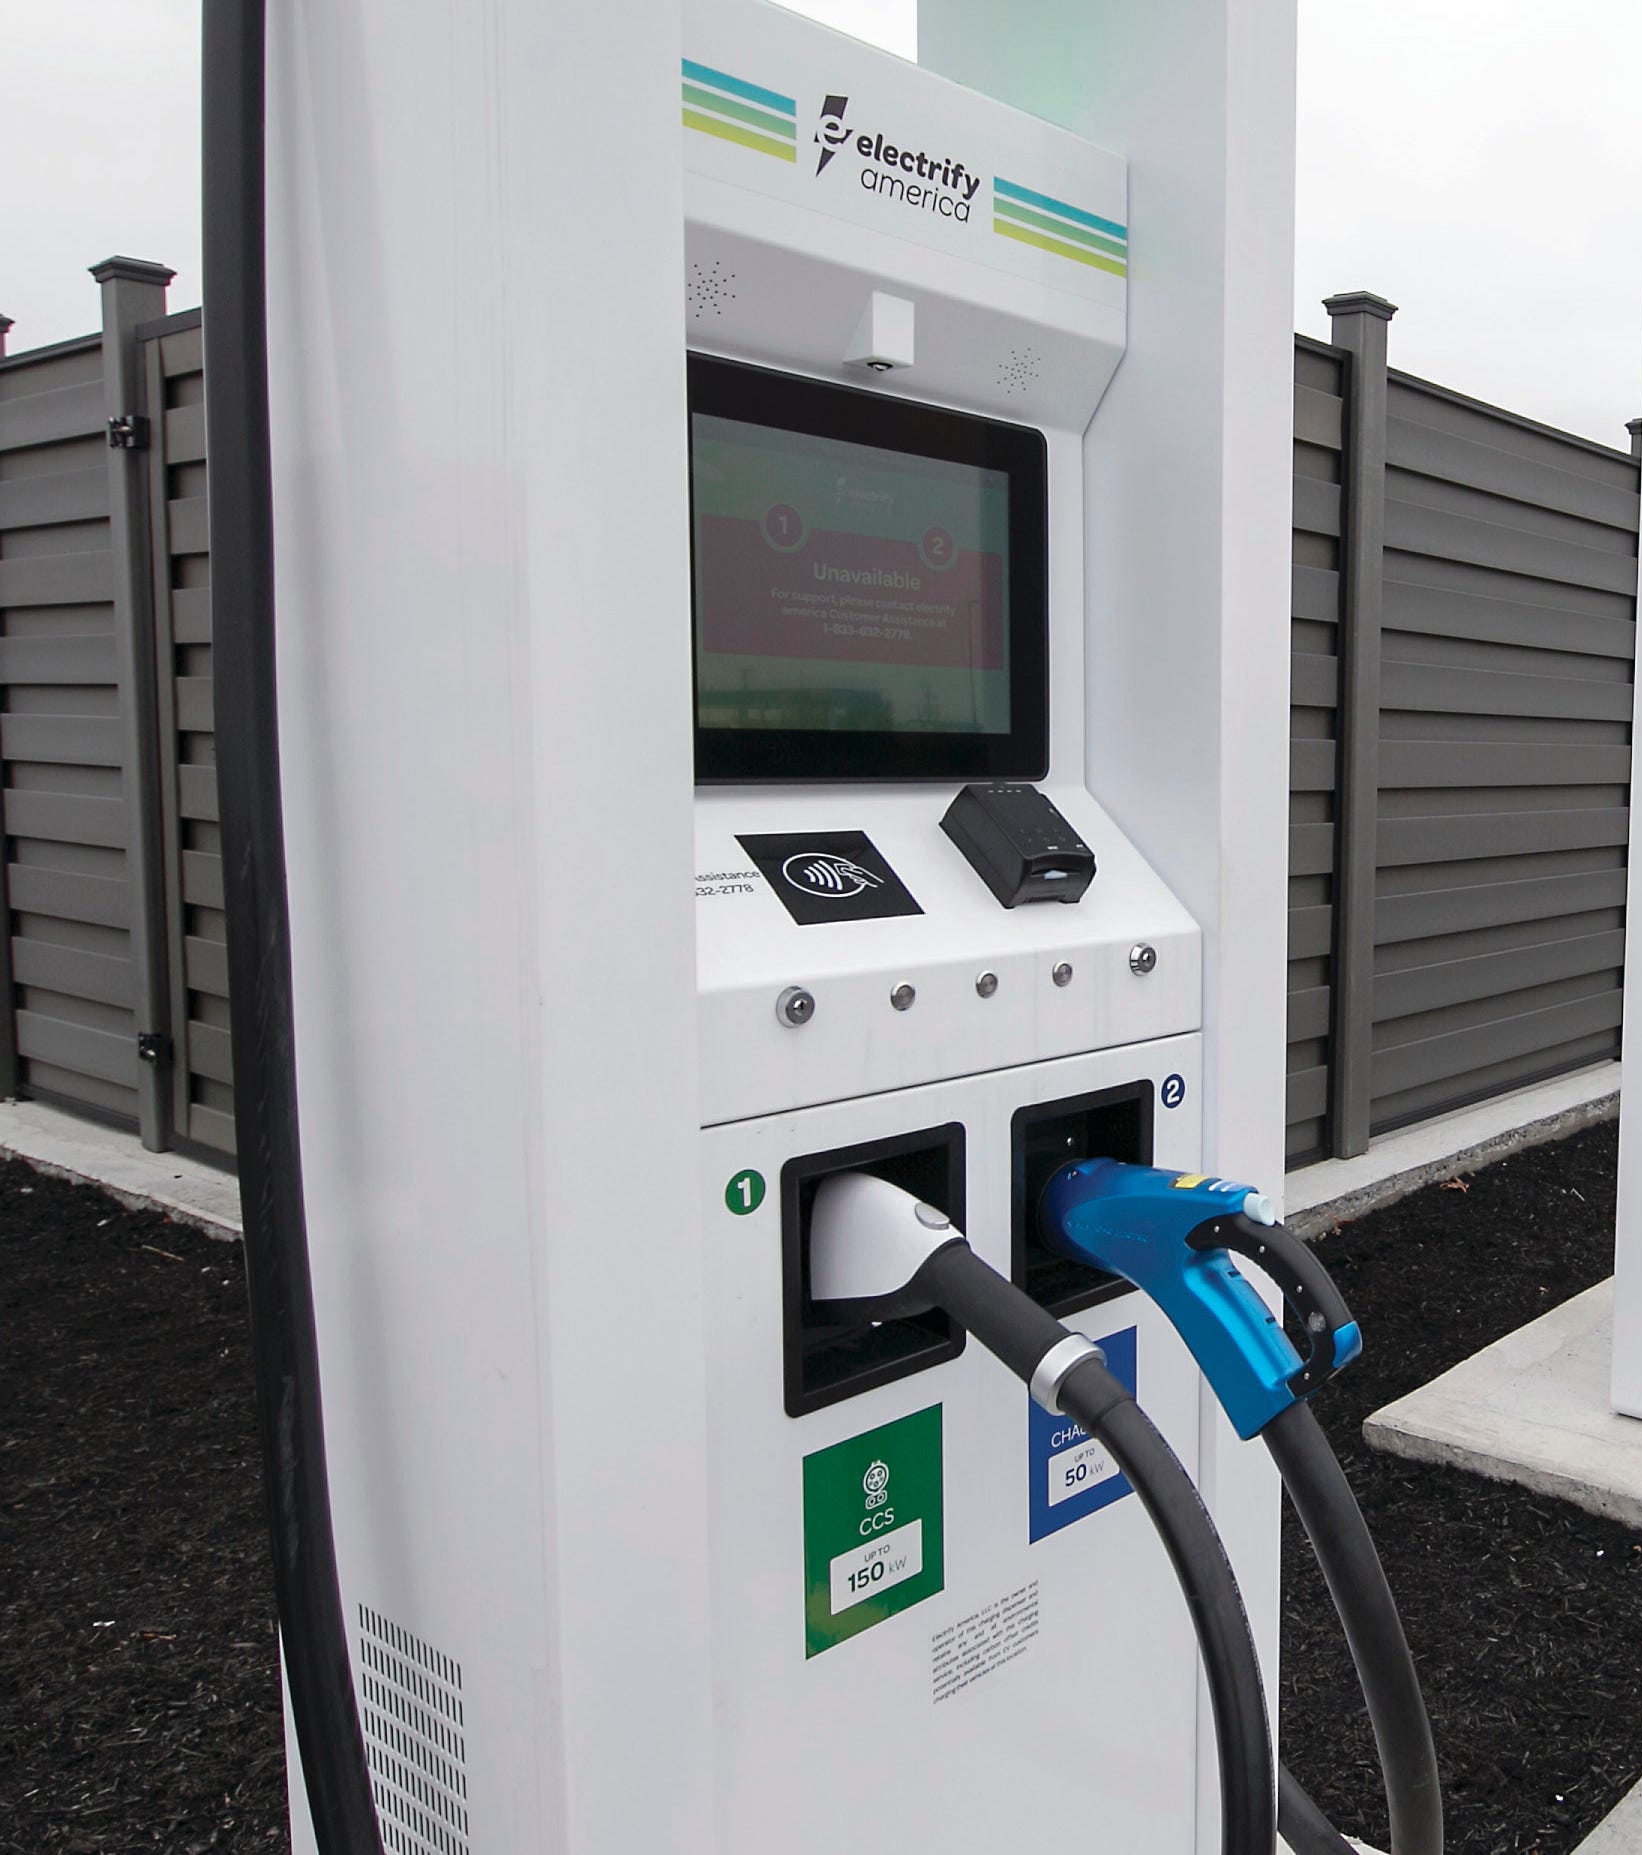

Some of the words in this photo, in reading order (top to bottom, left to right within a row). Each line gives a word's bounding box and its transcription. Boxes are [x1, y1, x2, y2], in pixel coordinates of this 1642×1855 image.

[857, 133, 980, 199] electrify
[860, 165, 971, 224] america
[778, 515, 787, 535] 1
[932, 536, 944, 555] 2
[813, 562, 920, 591] Unavailable
[771, 588, 791, 599] For
[829, 609, 880, 622] Customer
[695, 871, 760, 881] ssistance
[695, 884, 754, 896] 32-2778
[1167, 1079, 1180, 1103] 2
[737, 1176, 751, 1207] 1
[1074, 1453, 1084, 1463] UP
[1085, 1448, 1095, 1458] TO
[1065, 1463, 1087, 1486] 50
[1090, 1460, 1105, 1476] kW
[859, 1507, 895, 1536] CCS
[864, 1551, 877, 1563] UP
[877, 1544, 891, 1556] TO
[847, 1561, 885, 1592] 150
[888, 1555, 907, 1574] kW
[981, 1605, 992, 1615] LLC
